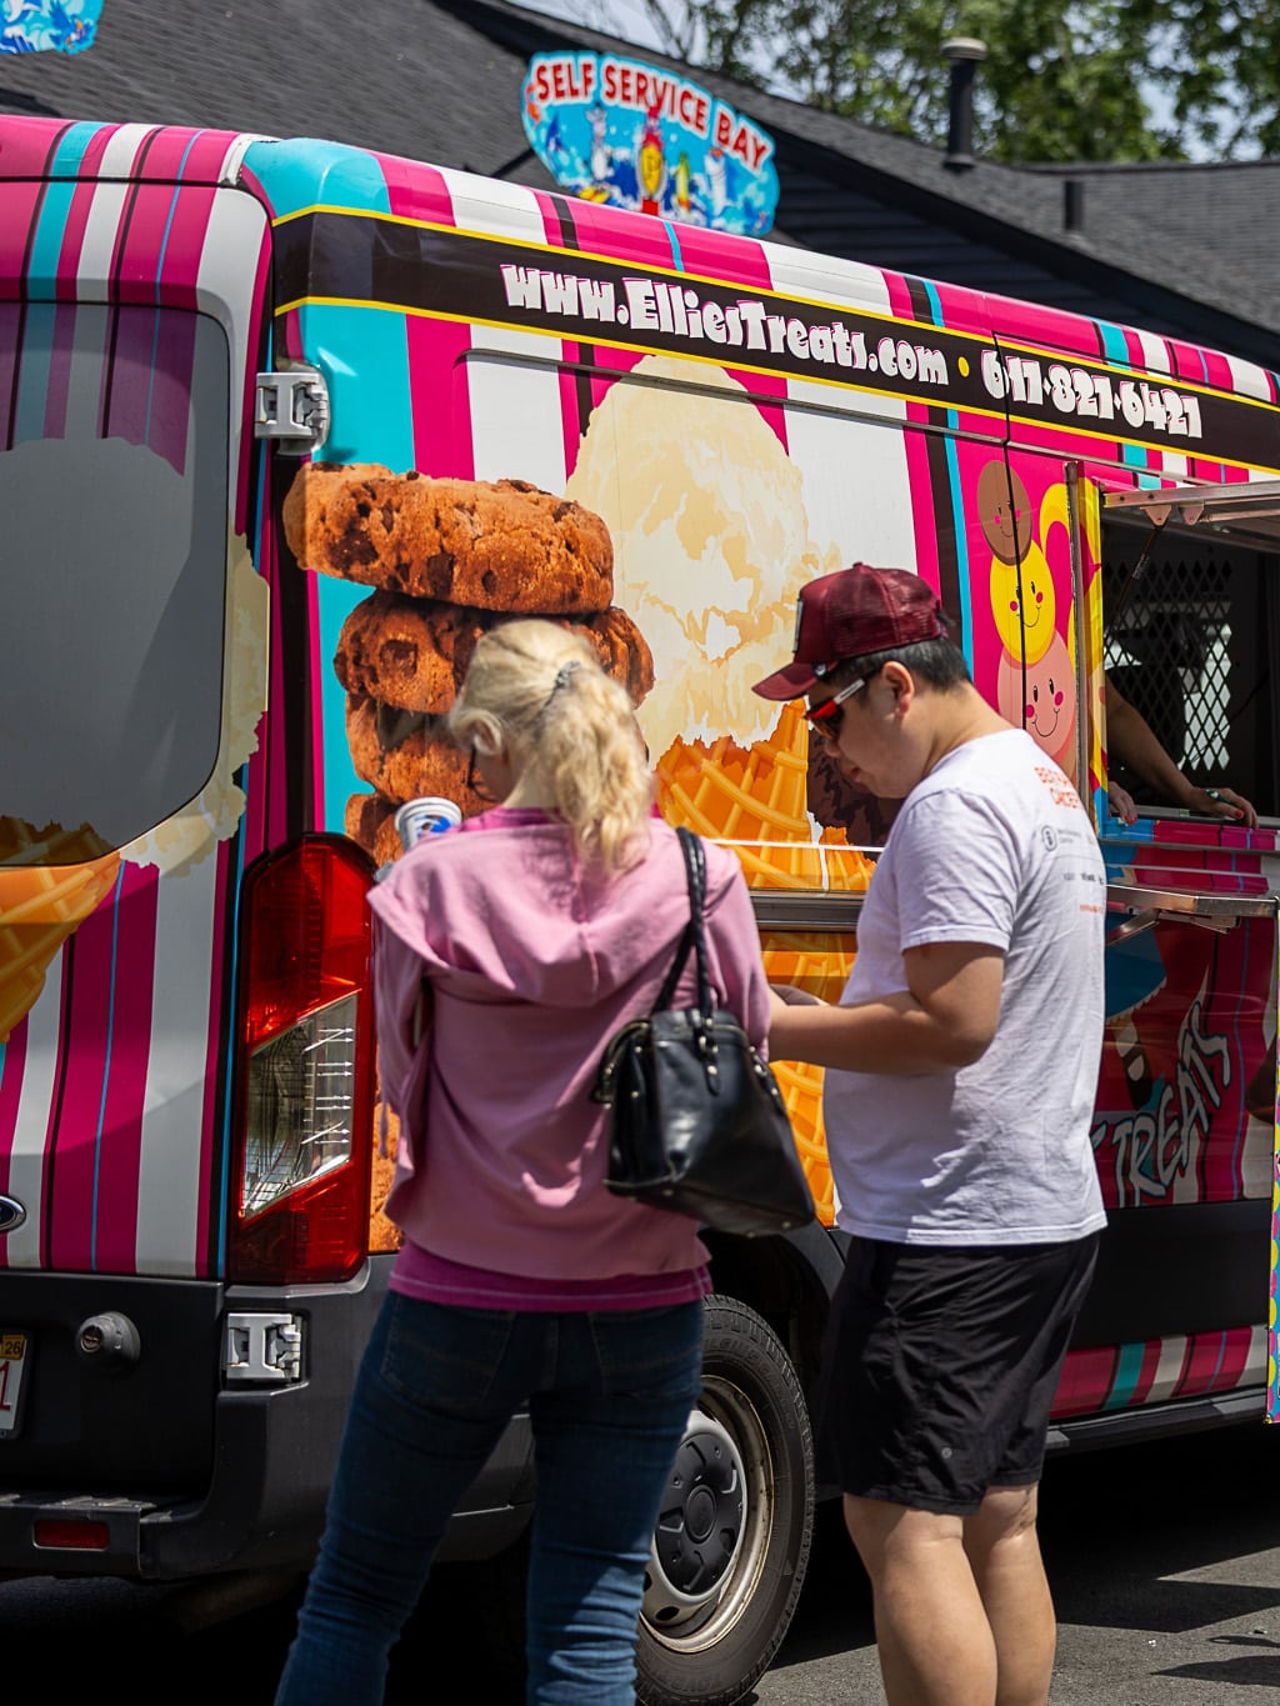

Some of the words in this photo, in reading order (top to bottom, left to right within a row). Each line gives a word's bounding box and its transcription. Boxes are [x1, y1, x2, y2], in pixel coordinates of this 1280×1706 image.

[536, 62, 594, 101] SELF
[603, 64, 710, 133] SERVICE
[716, 111, 767, 169] BAY
